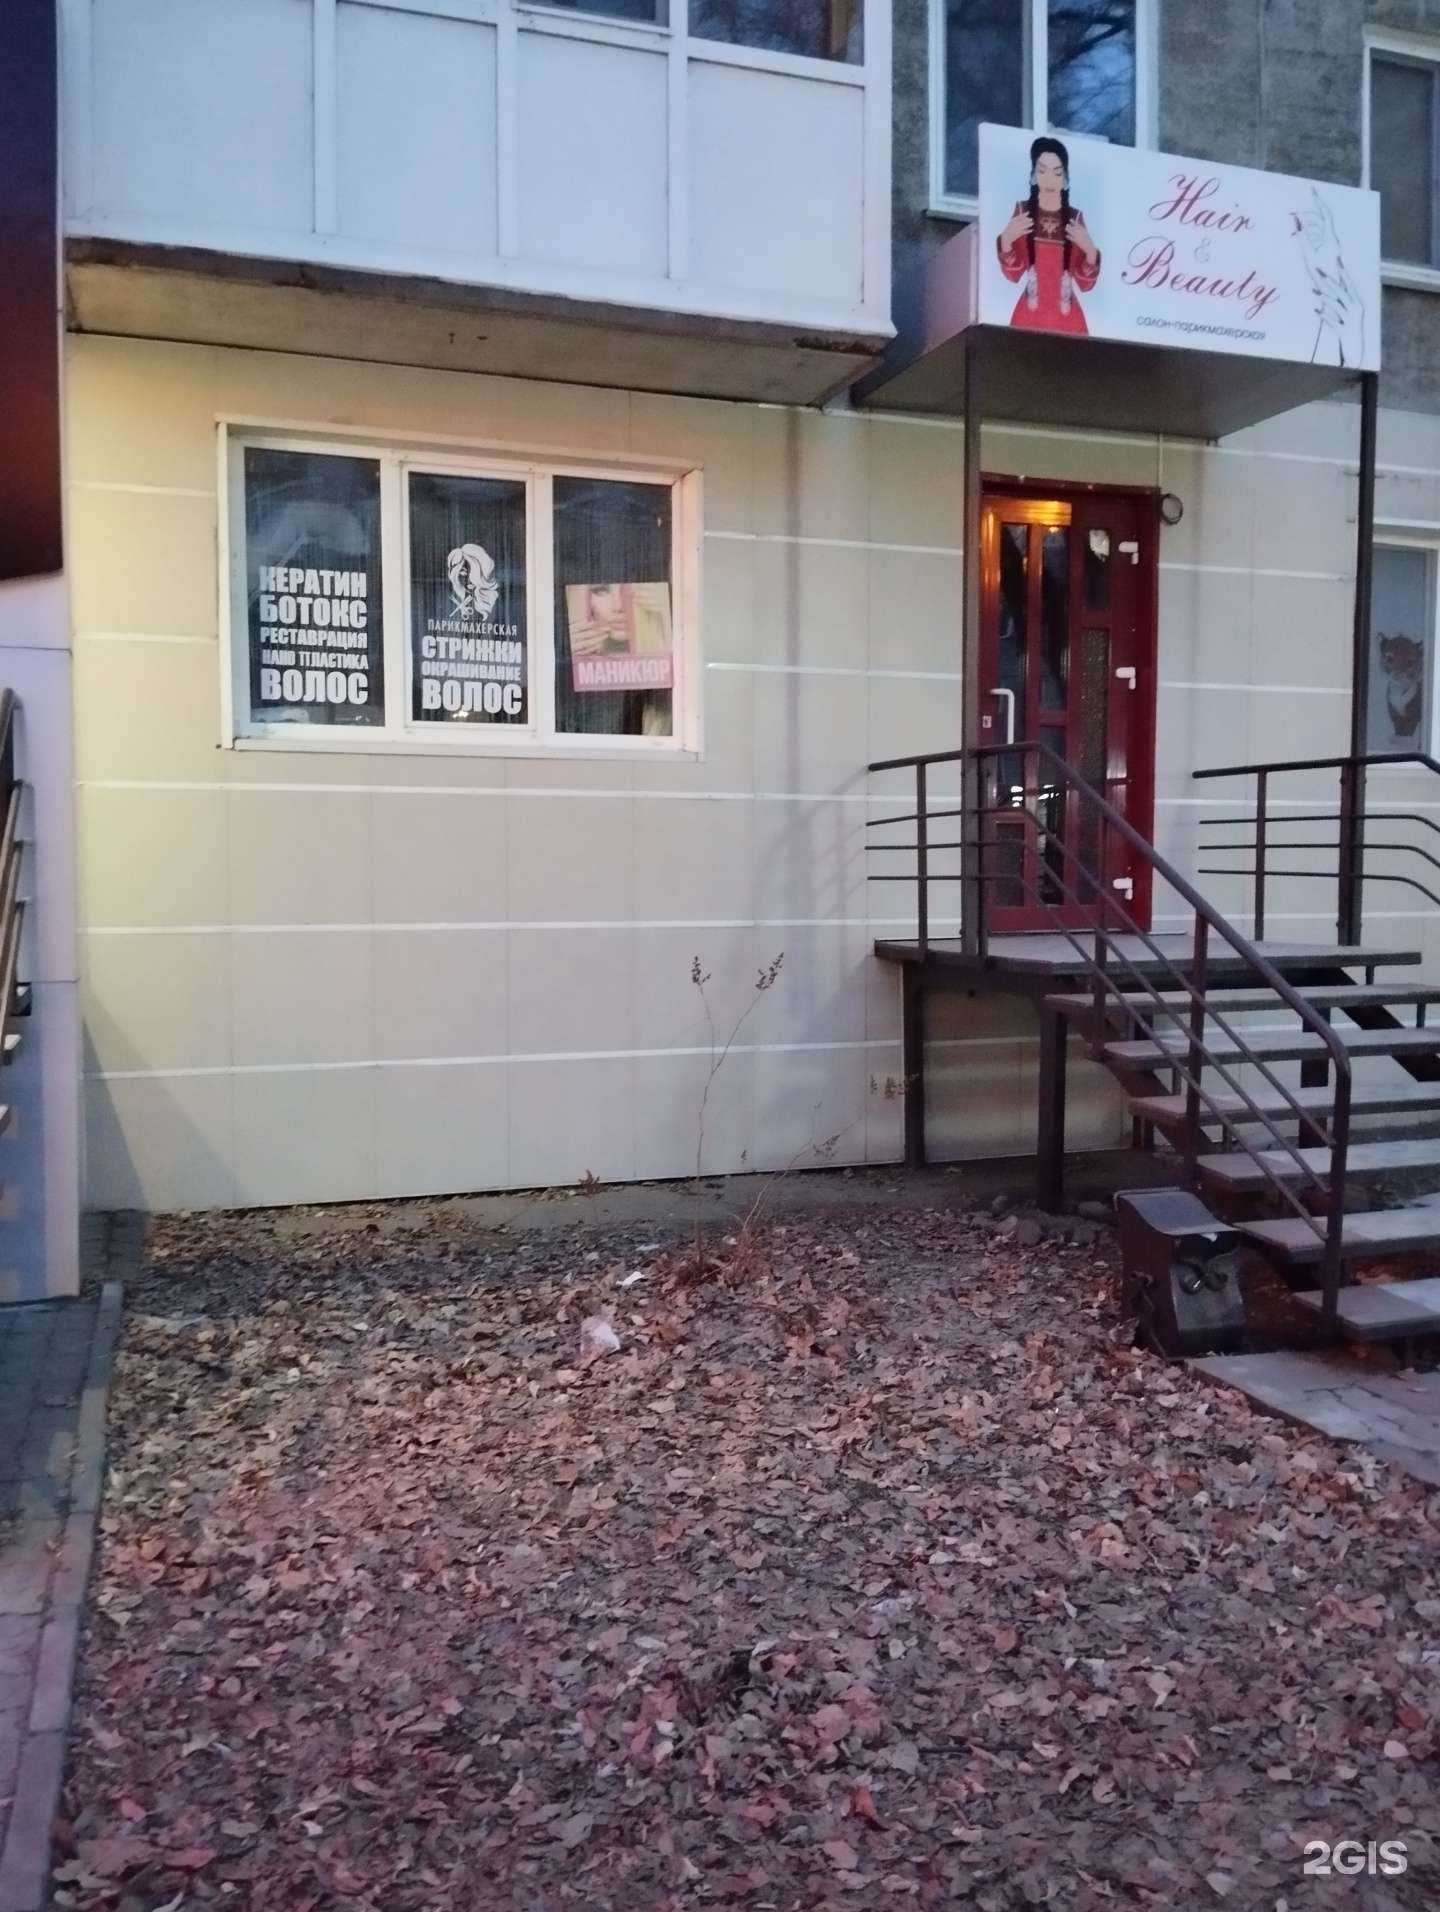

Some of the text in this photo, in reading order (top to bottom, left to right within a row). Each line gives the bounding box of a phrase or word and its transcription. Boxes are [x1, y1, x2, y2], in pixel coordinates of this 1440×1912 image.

[1148, 173, 1256, 234] Hair
[1121, 235, 1280, 320] Beauty
[1136, 315, 1267, 341] салон-парикмахерская
[259, 565, 367, 598] КЕРАТИН
[259, 594, 368, 629] БОТОКС
[260, 626, 368, 650] РЕСТАВРАЦИЯ
[427, 618, 518, 637] ПАРИКМАХЕРСКАЯ
[262, 649, 369, 670] НАНО ПЛАСТИКА
[422, 635, 522, 665] СТРИЖКИ
[260, 667, 369, 705] ВОЛОС
[421, 661, 522, 682] ОКРАШИВАНИЕ
[577, 658, 671, 685] МАНИКЮР
[422, 678, 523, 716] ВОЛОС
